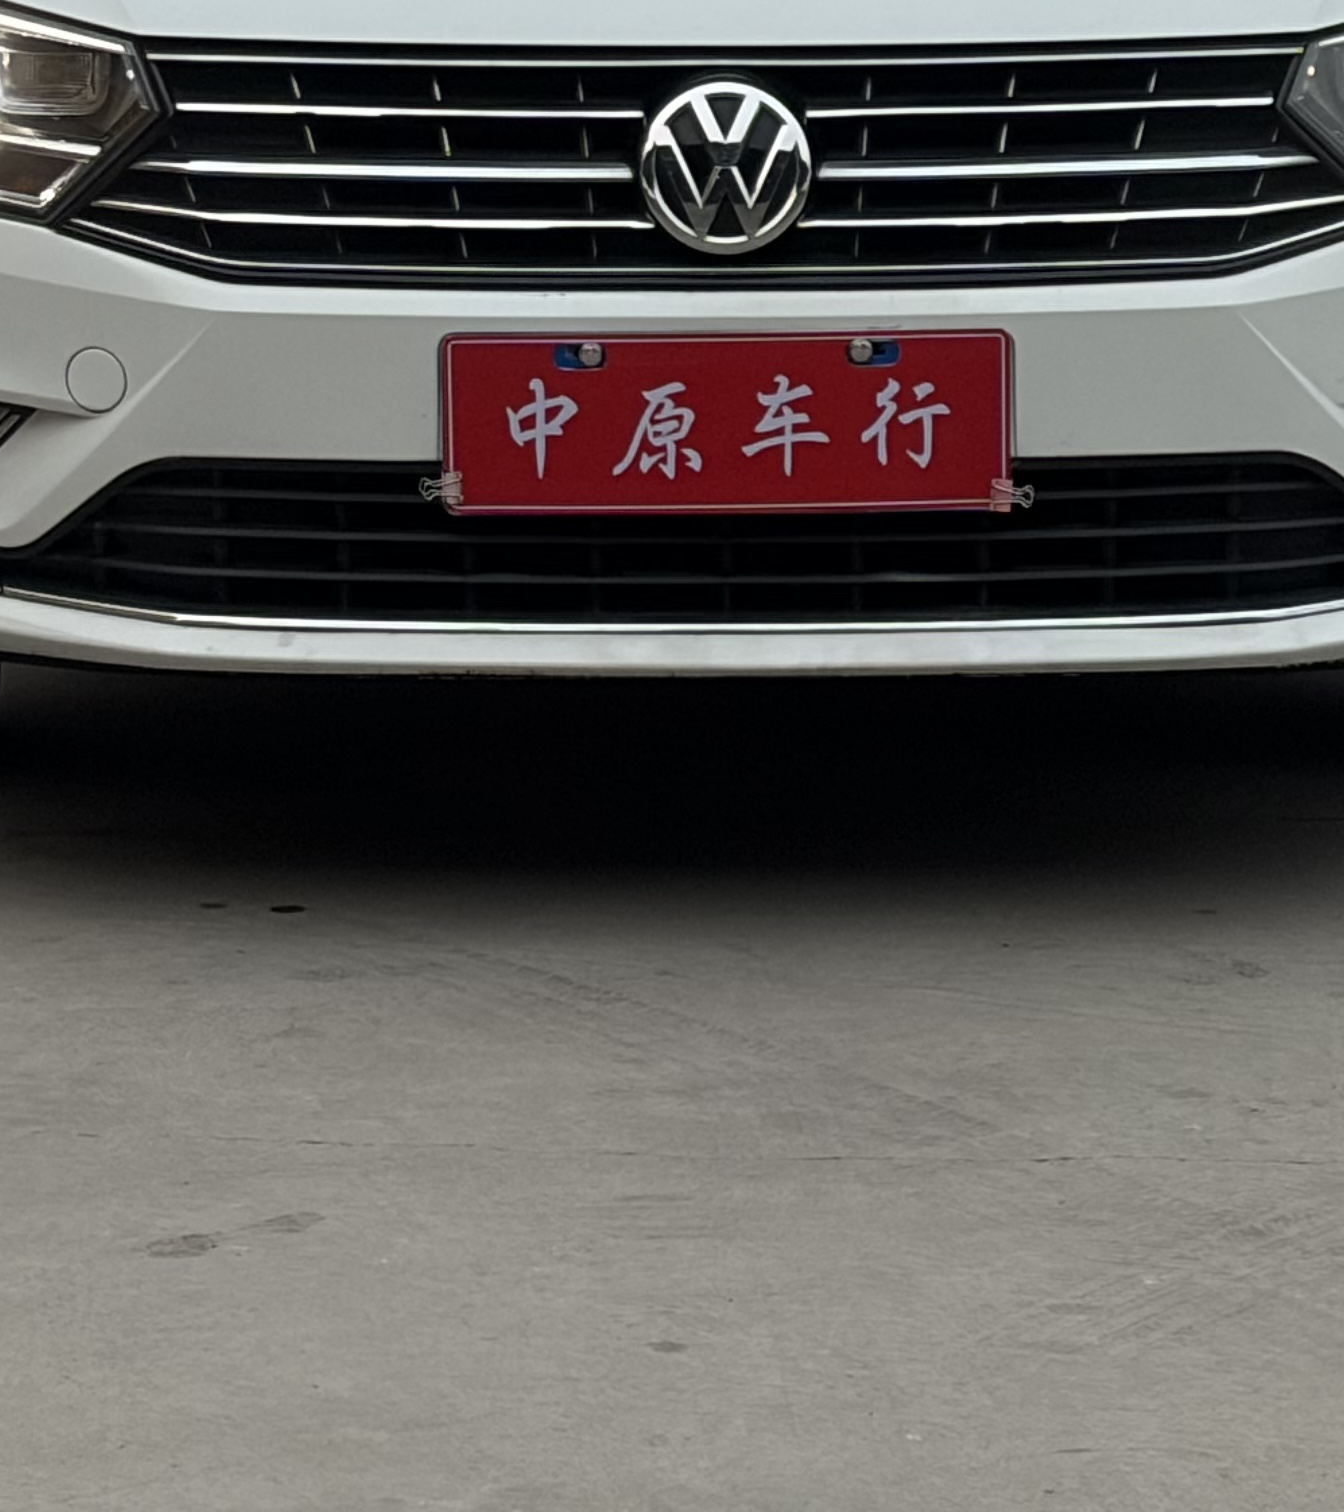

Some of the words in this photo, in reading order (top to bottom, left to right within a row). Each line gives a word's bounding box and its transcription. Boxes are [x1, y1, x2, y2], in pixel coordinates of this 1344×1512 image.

[641, 81, 811, 255] VW
[505, 374, 952, 480] 中原车行
